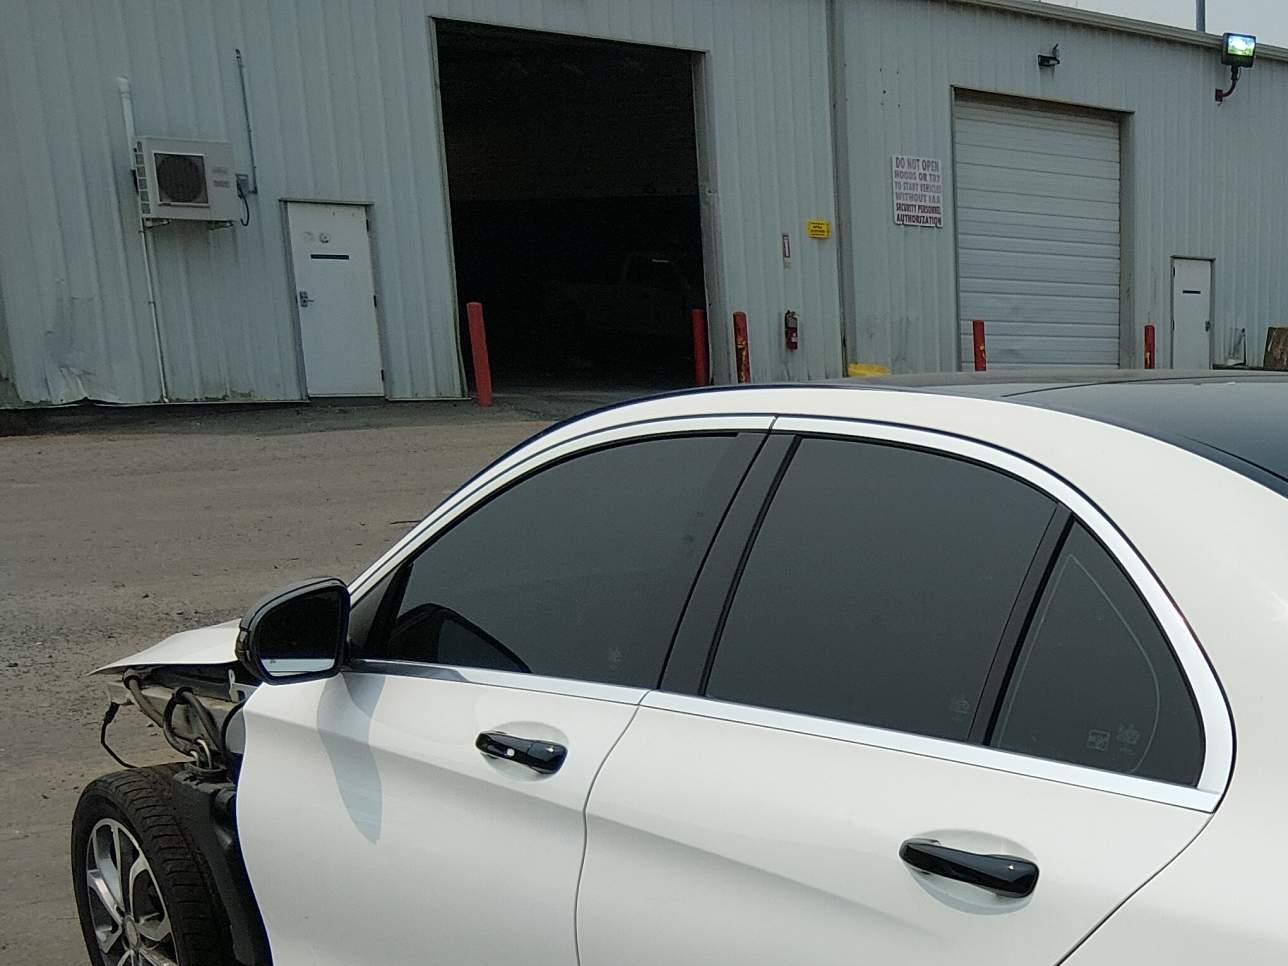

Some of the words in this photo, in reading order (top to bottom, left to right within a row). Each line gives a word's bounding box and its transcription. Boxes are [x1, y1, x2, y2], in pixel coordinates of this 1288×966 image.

[895, 157, 905, 169] DO
[907, 158, 920, 171] NOT
[921, 159, 940, 172] OPEN
[895, 170, 917, 181] HOODS
[918, 172, 928, 182] OR
[929, 173, 941, 183] TRY
[895, 181, 902, 190] TO
[903, 182, 919, 192] START
[895, 192, 927, 203] WITHOUT
[896, 202, 917, 213] SECURITY
[896, 213, 942, 226] AUTHORIZATION
